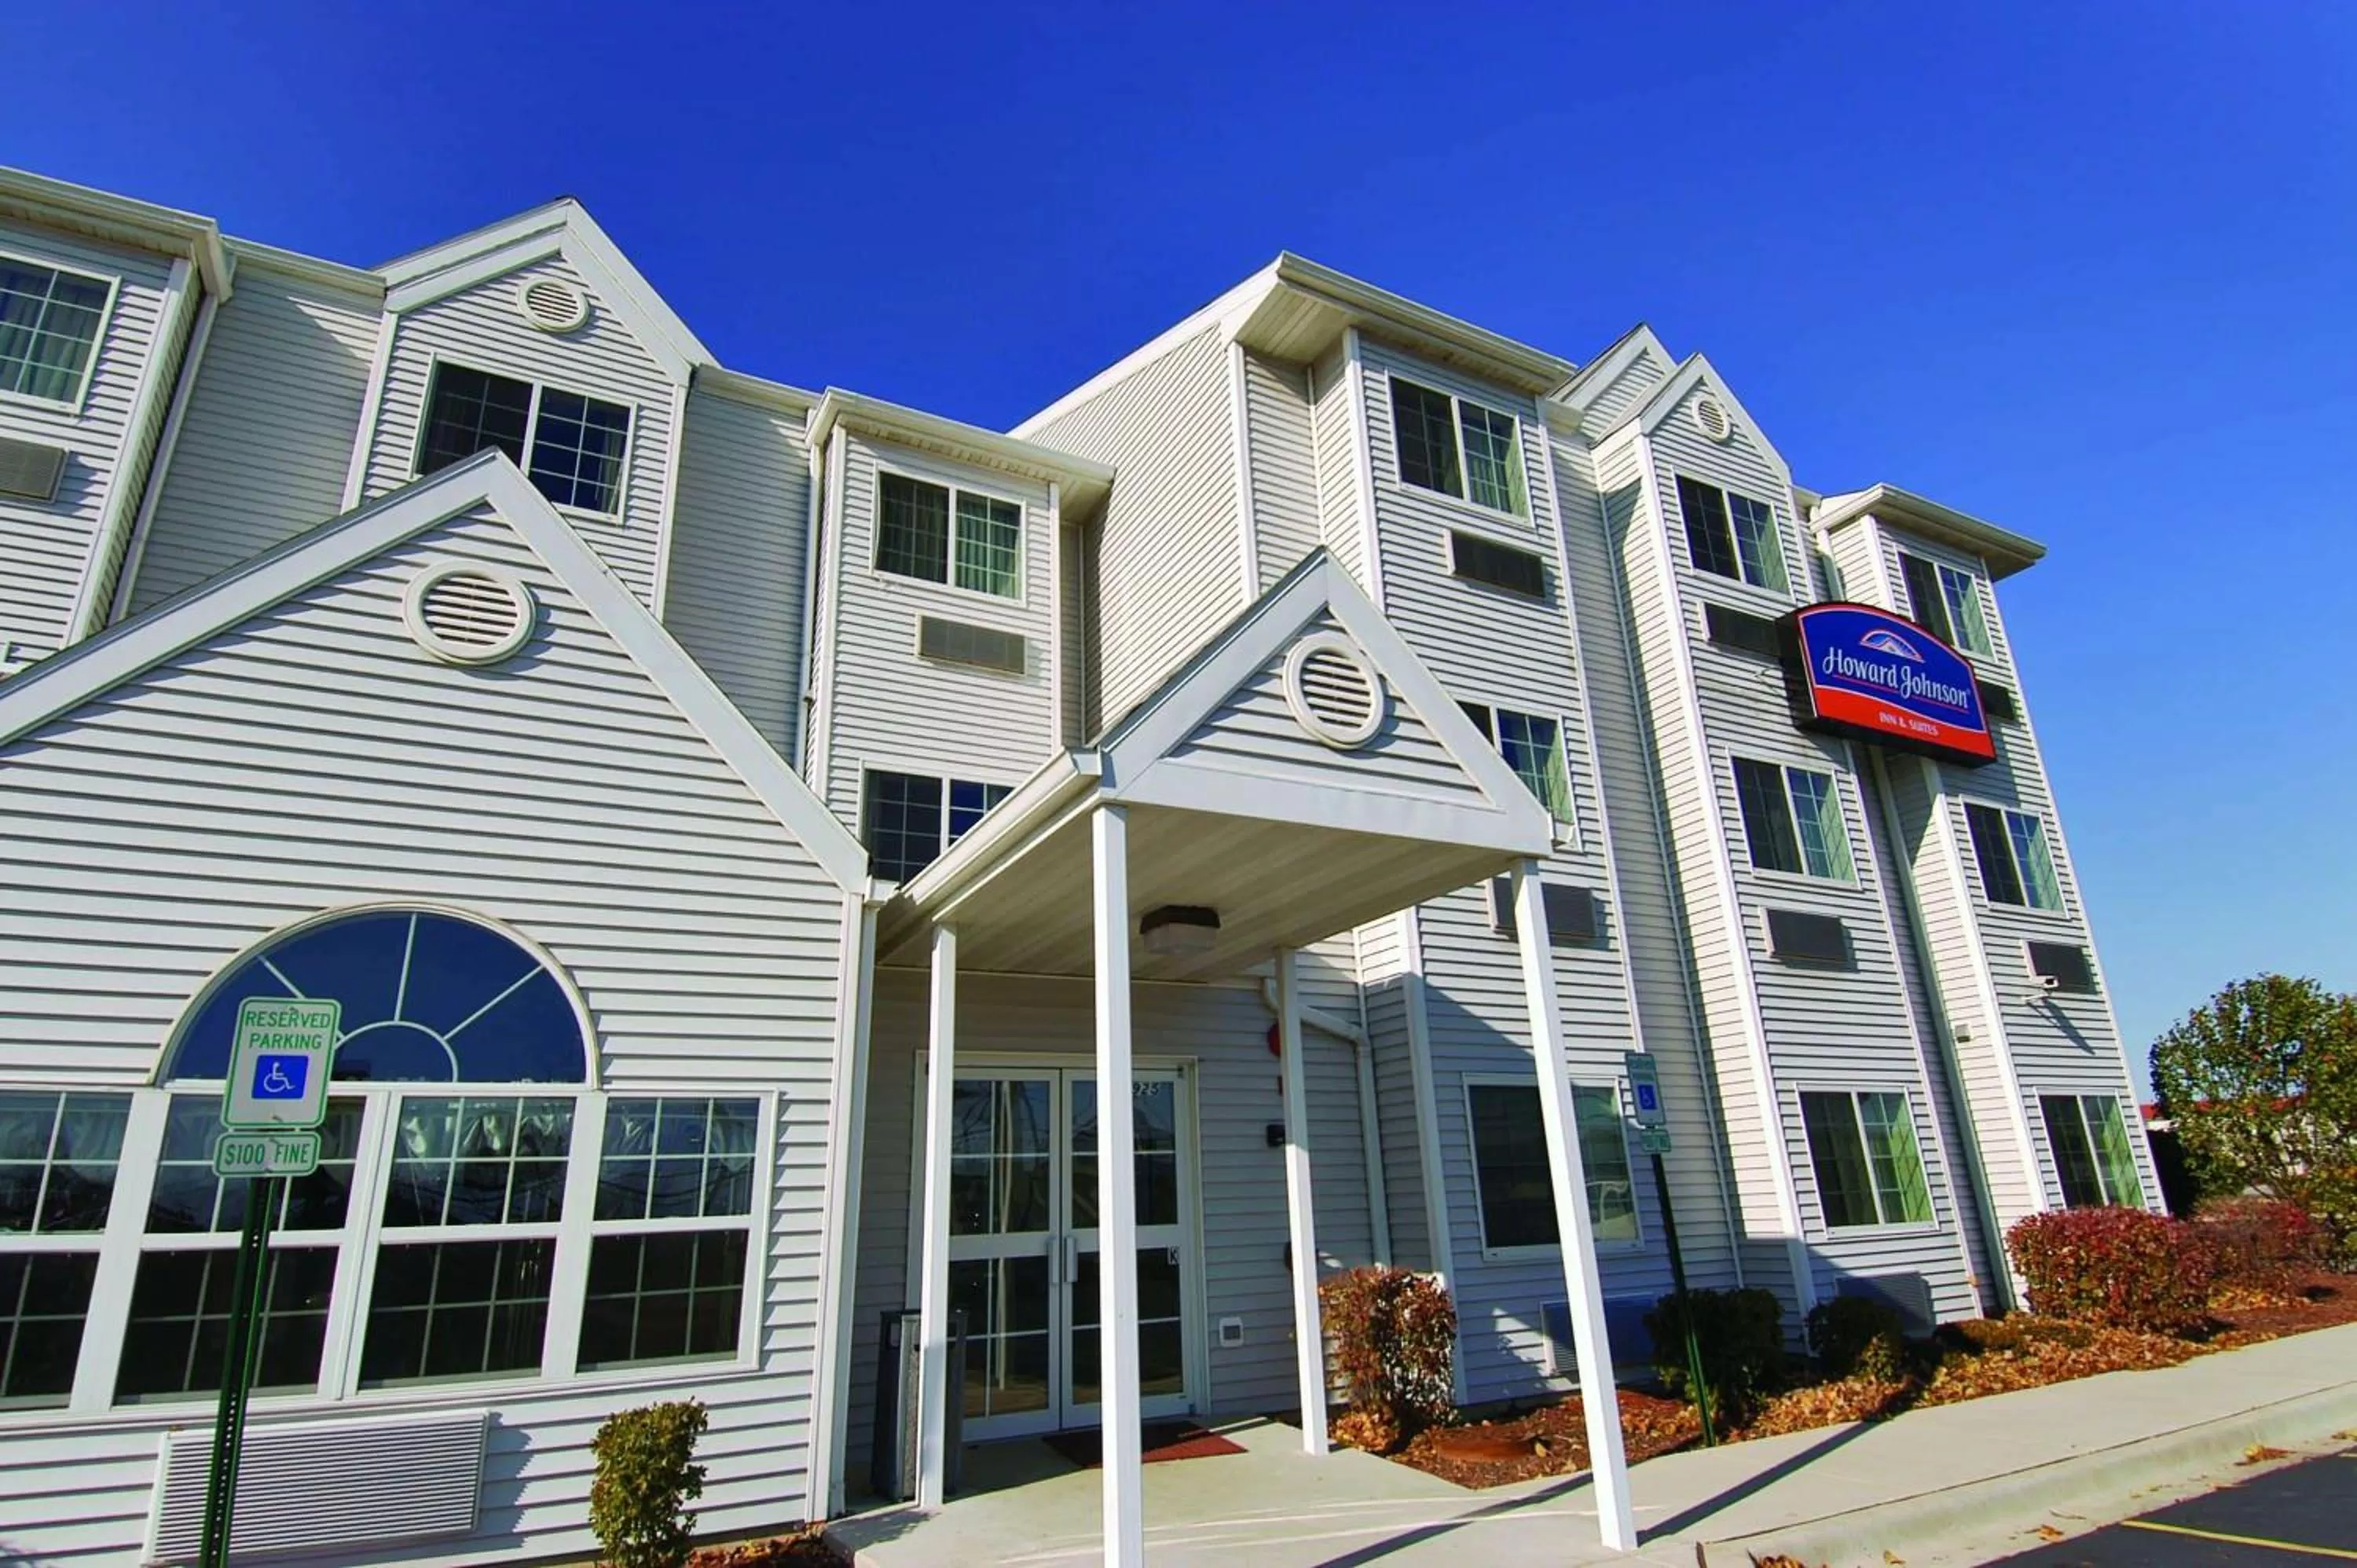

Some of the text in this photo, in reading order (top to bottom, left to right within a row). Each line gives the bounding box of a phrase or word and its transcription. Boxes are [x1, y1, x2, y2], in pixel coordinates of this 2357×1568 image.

[1823, 647, 1969, 709] Howard Johnson
[245, 1011, 331, 1028] RESERVED
[249, 1033, 322, 1050] PARKING
[225, 1144, 311, 1164] $100 FINE
